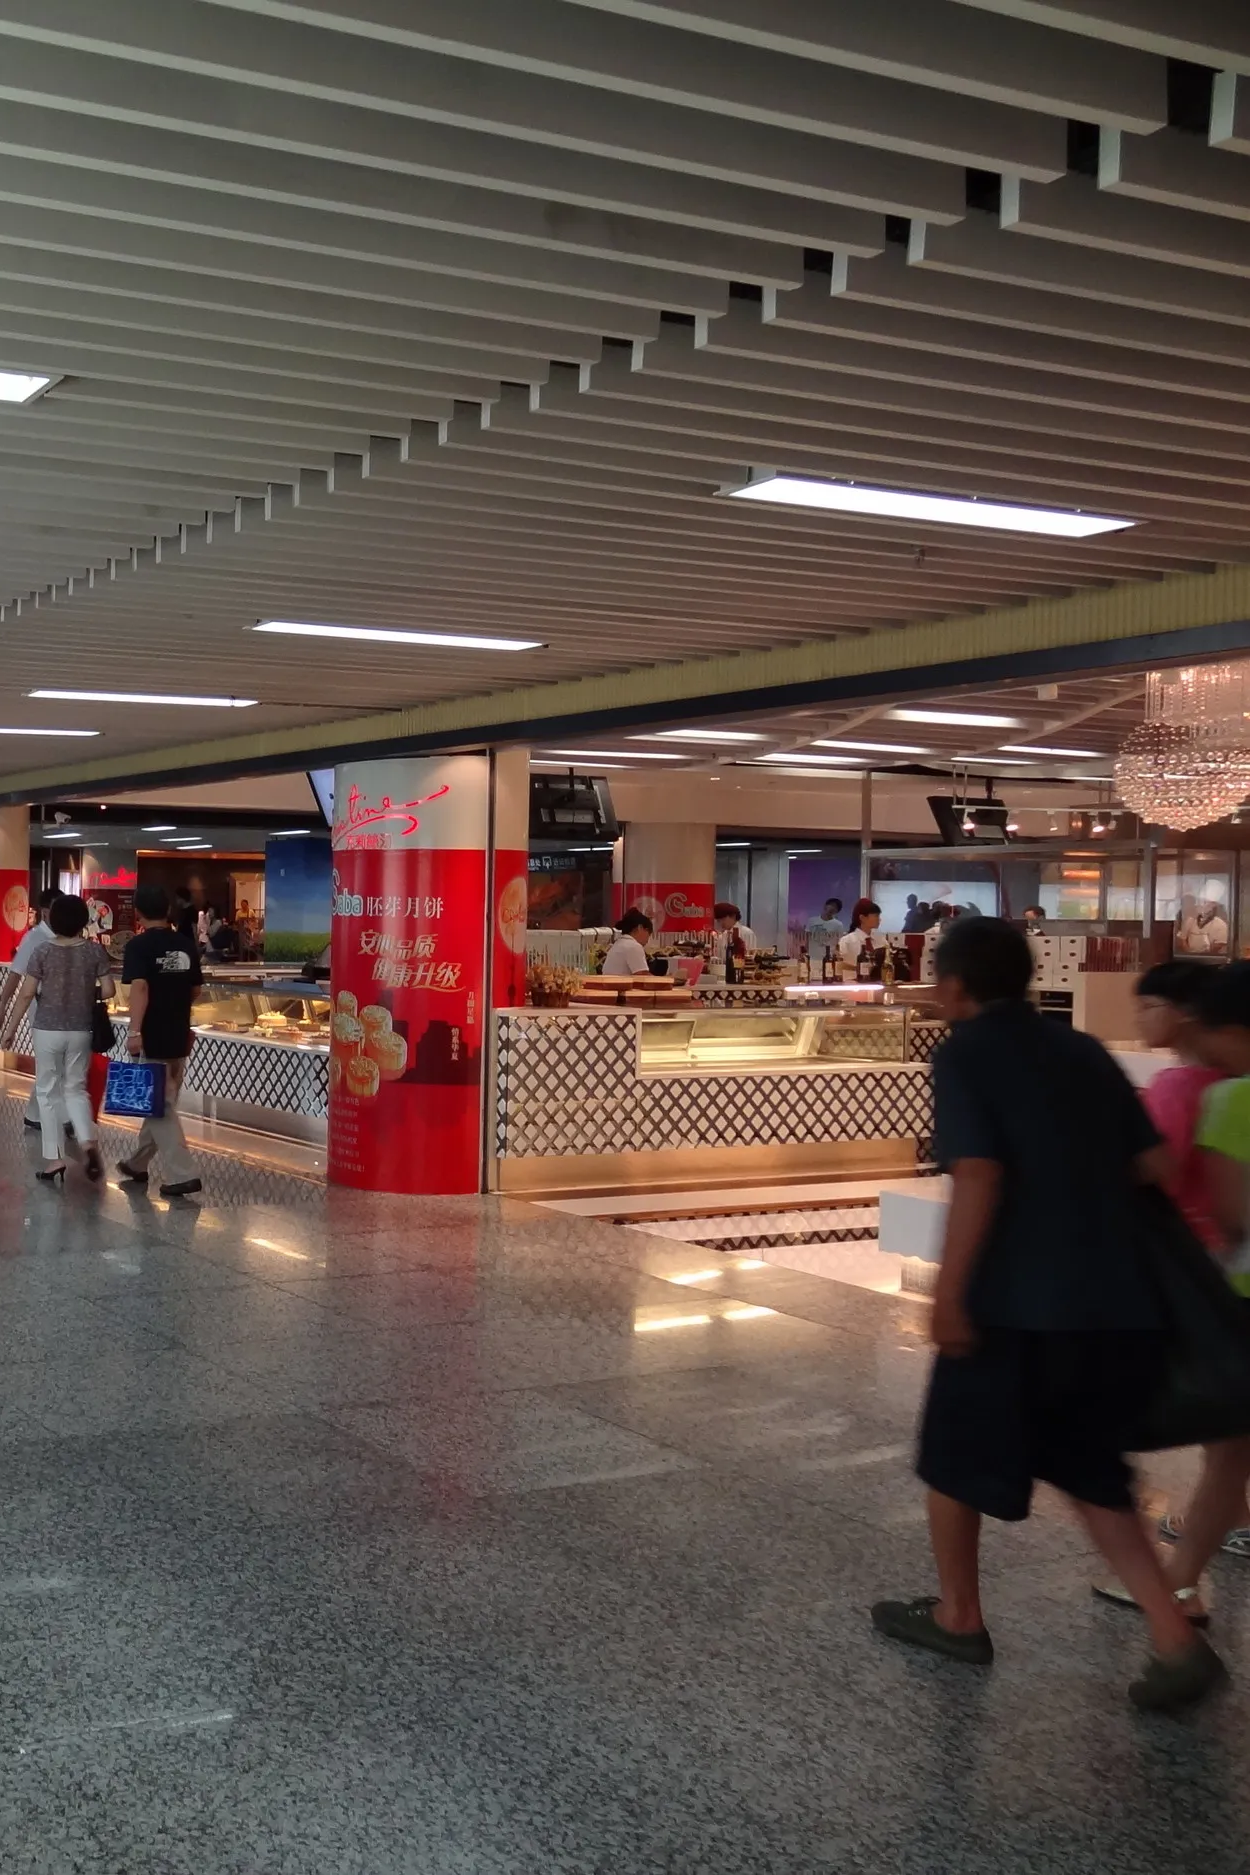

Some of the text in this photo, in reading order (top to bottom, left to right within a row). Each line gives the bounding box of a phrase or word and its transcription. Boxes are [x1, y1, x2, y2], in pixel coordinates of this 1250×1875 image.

[366, 896, 445, 919] 胚芽月饼
[358, 929, 439, 960] 安心品质
[371, 957, 463, 989] 健康升级
